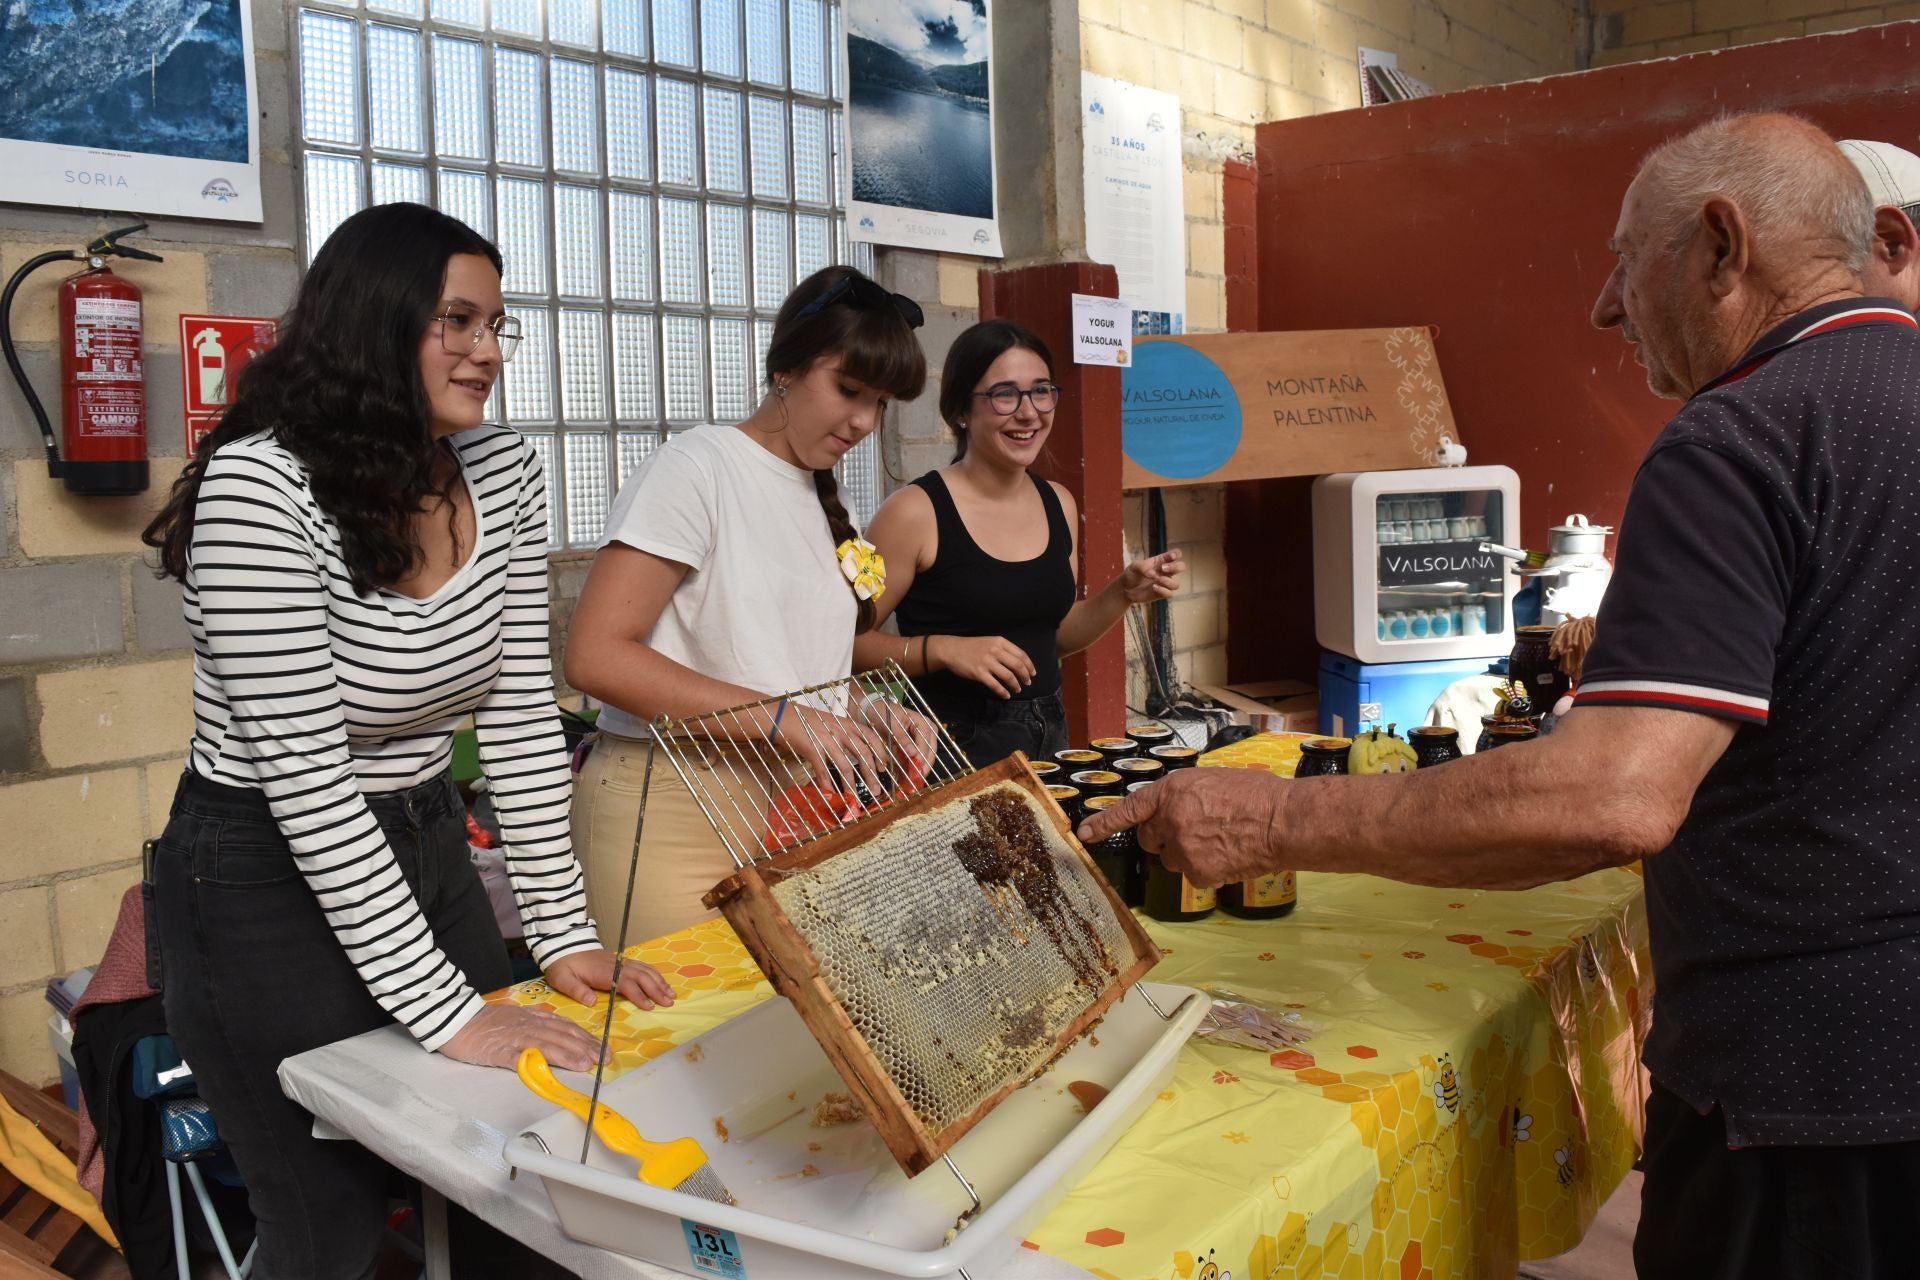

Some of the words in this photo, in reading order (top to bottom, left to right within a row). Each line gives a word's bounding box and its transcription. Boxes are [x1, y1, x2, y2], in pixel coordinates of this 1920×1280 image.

[1123, 138, 1146, 151] AÑOS
[64, 170, 128, 188] SORIA
[905, 223, 948, 236] SEGOVIA
[1089, 318, 1115, 328] YOGUR
[1080, 335, 1123, 347] VALSOLANA
[1266, 374, 1368, 396] MONTAÑA
[1121, 388, 1221, 402] VALSOLANA
[1273, 406, 1378, 427] PALENTINA
[1385, 555, 1495, 573] VALSOLANA
[692, 1230, 733, 1256] 13L
